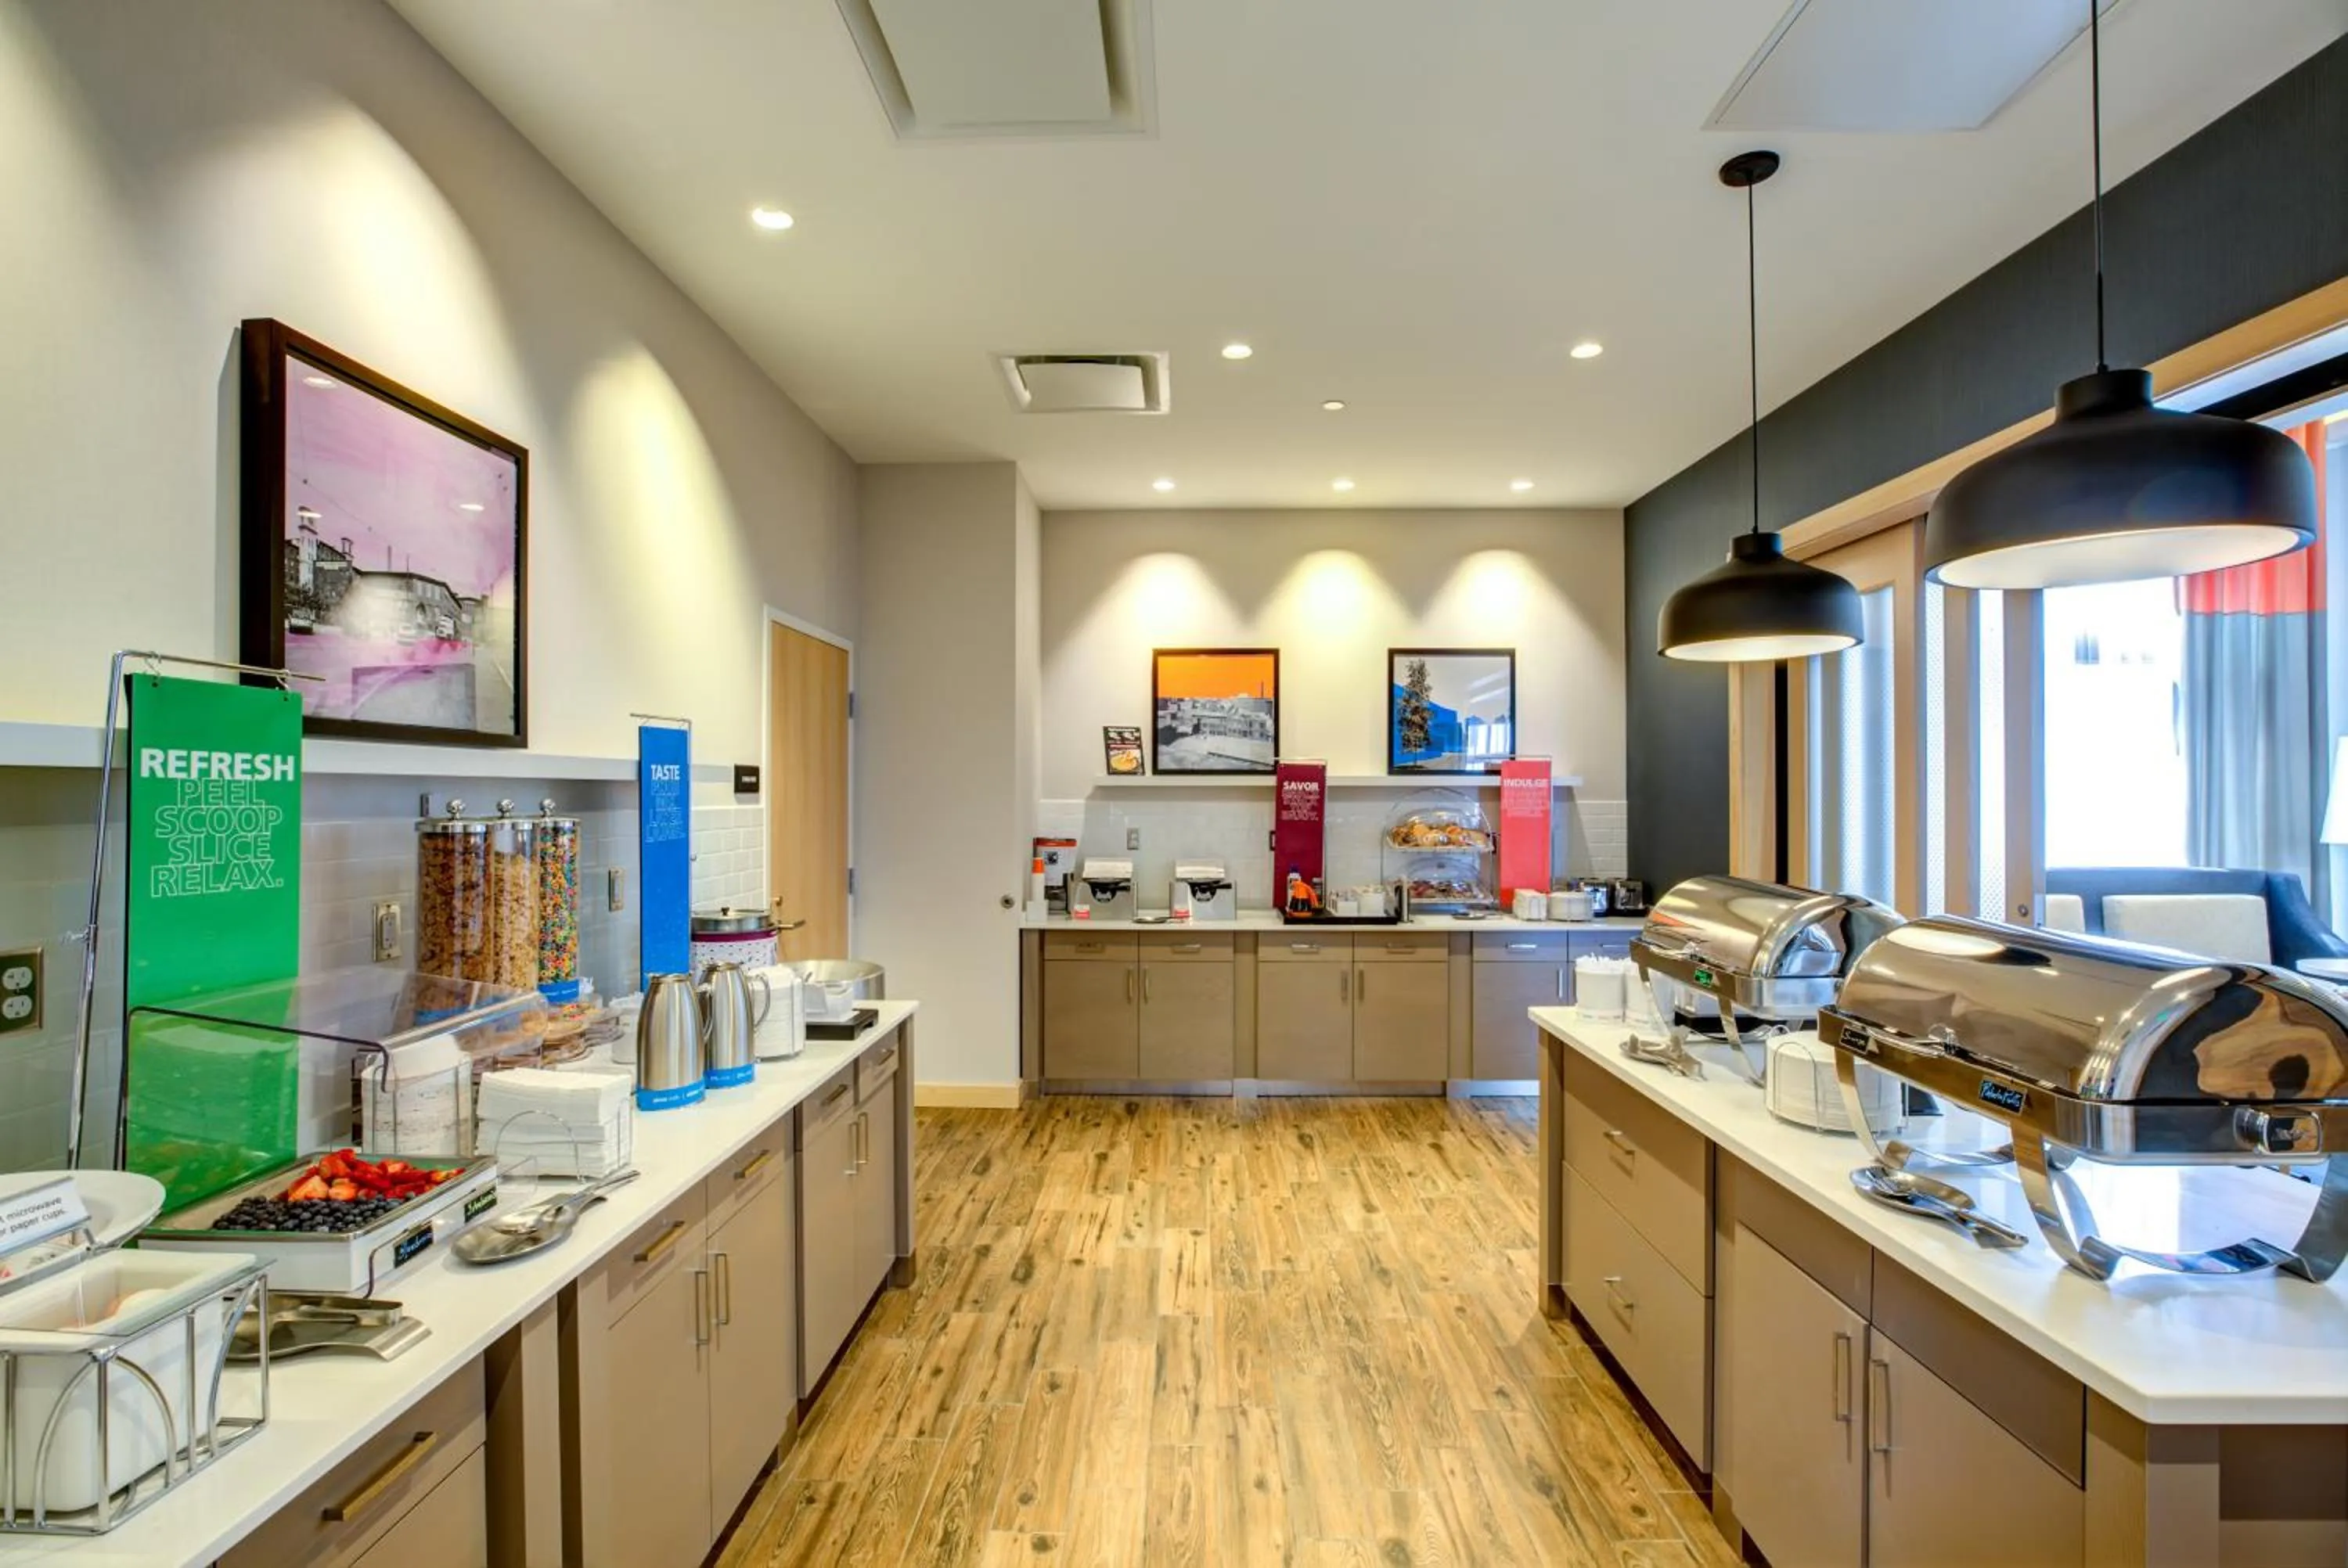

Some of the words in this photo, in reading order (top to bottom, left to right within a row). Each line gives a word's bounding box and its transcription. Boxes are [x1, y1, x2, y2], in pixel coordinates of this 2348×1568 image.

[140, 748, 295, 781] REFRESH
[650, 764, 680, 780] TASTE
[178, 778, 266, 810] PEEL
[1283, 781, 1319, 791] SAVOR
[155, 805, 283, 837] SCOOP
[168, 833, 272, 865] SLICE
[151, 859, 284, 897] RELAX.
[6, 1196, 62, 1221] microwave
[10, 1217, 39, 1234] paper
